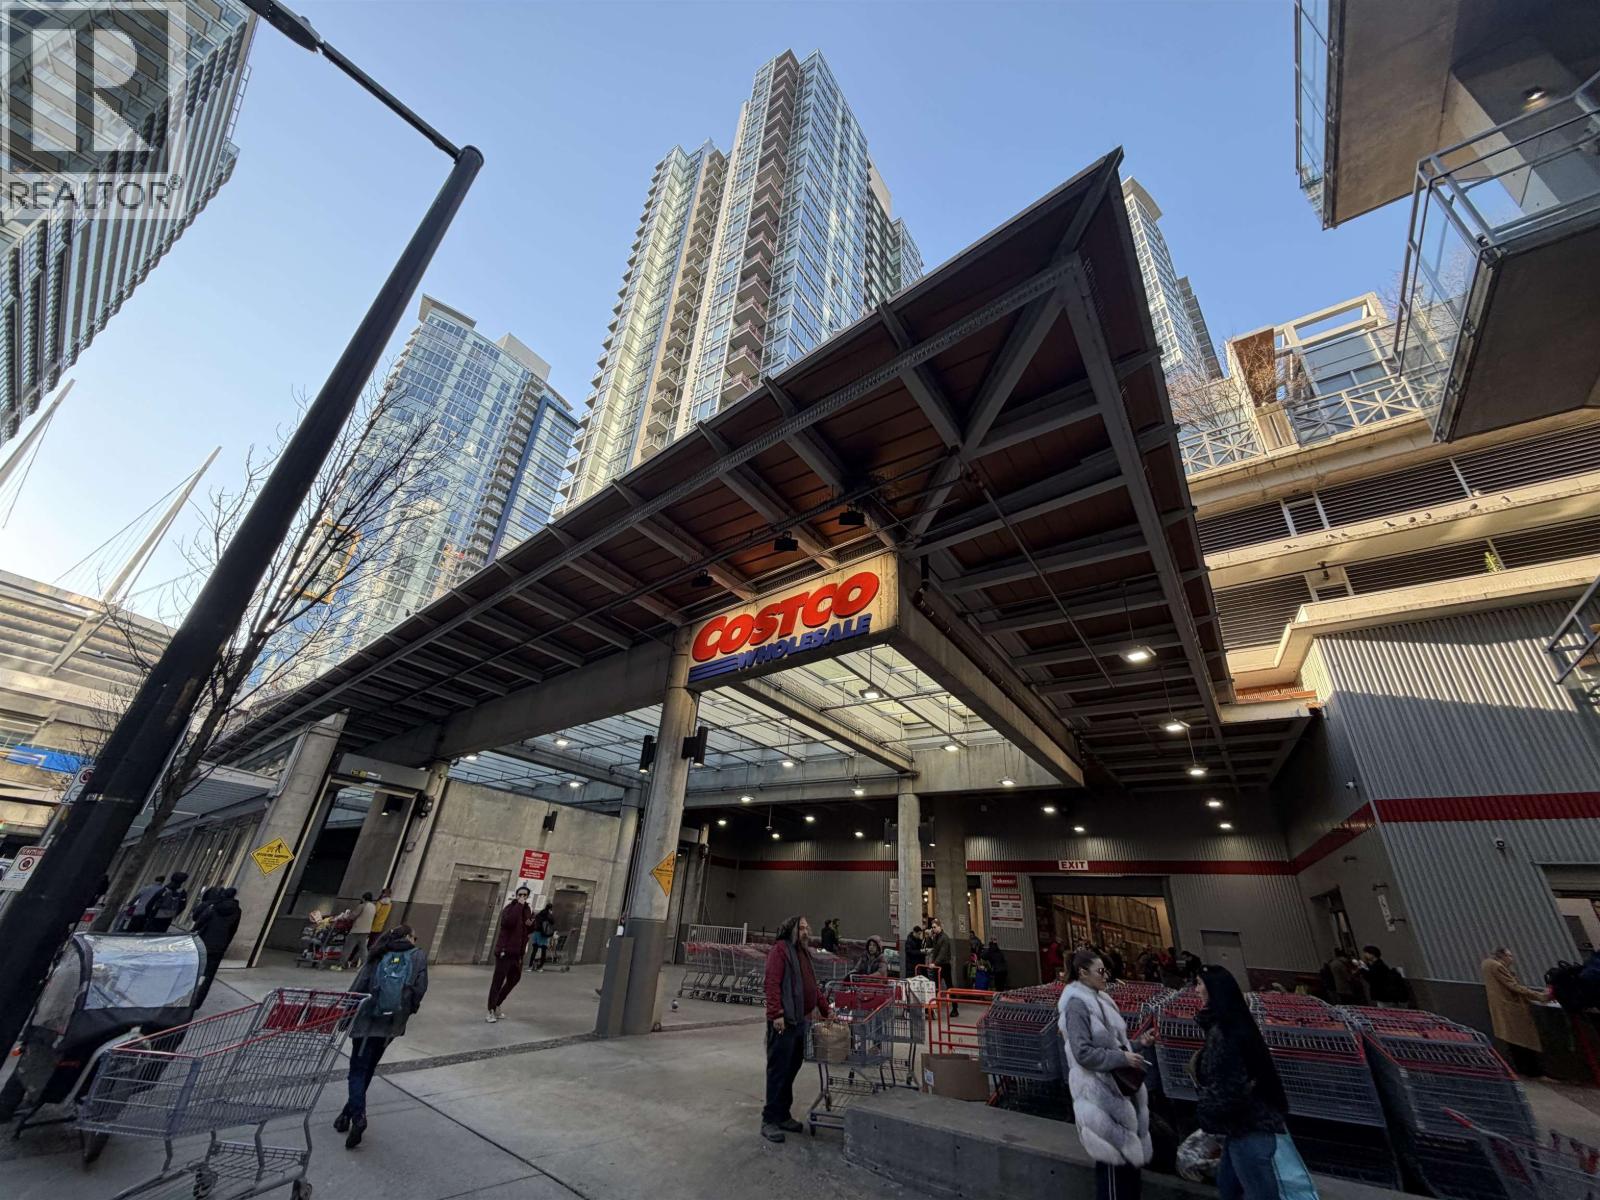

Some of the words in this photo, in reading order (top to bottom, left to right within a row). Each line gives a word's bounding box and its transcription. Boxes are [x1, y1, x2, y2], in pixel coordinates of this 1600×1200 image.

[692, 571, 880, 662] COSTCO
[737, 613, 872, 670] WHOLESALE
[1061, 861, 1085, 869] EXIT
